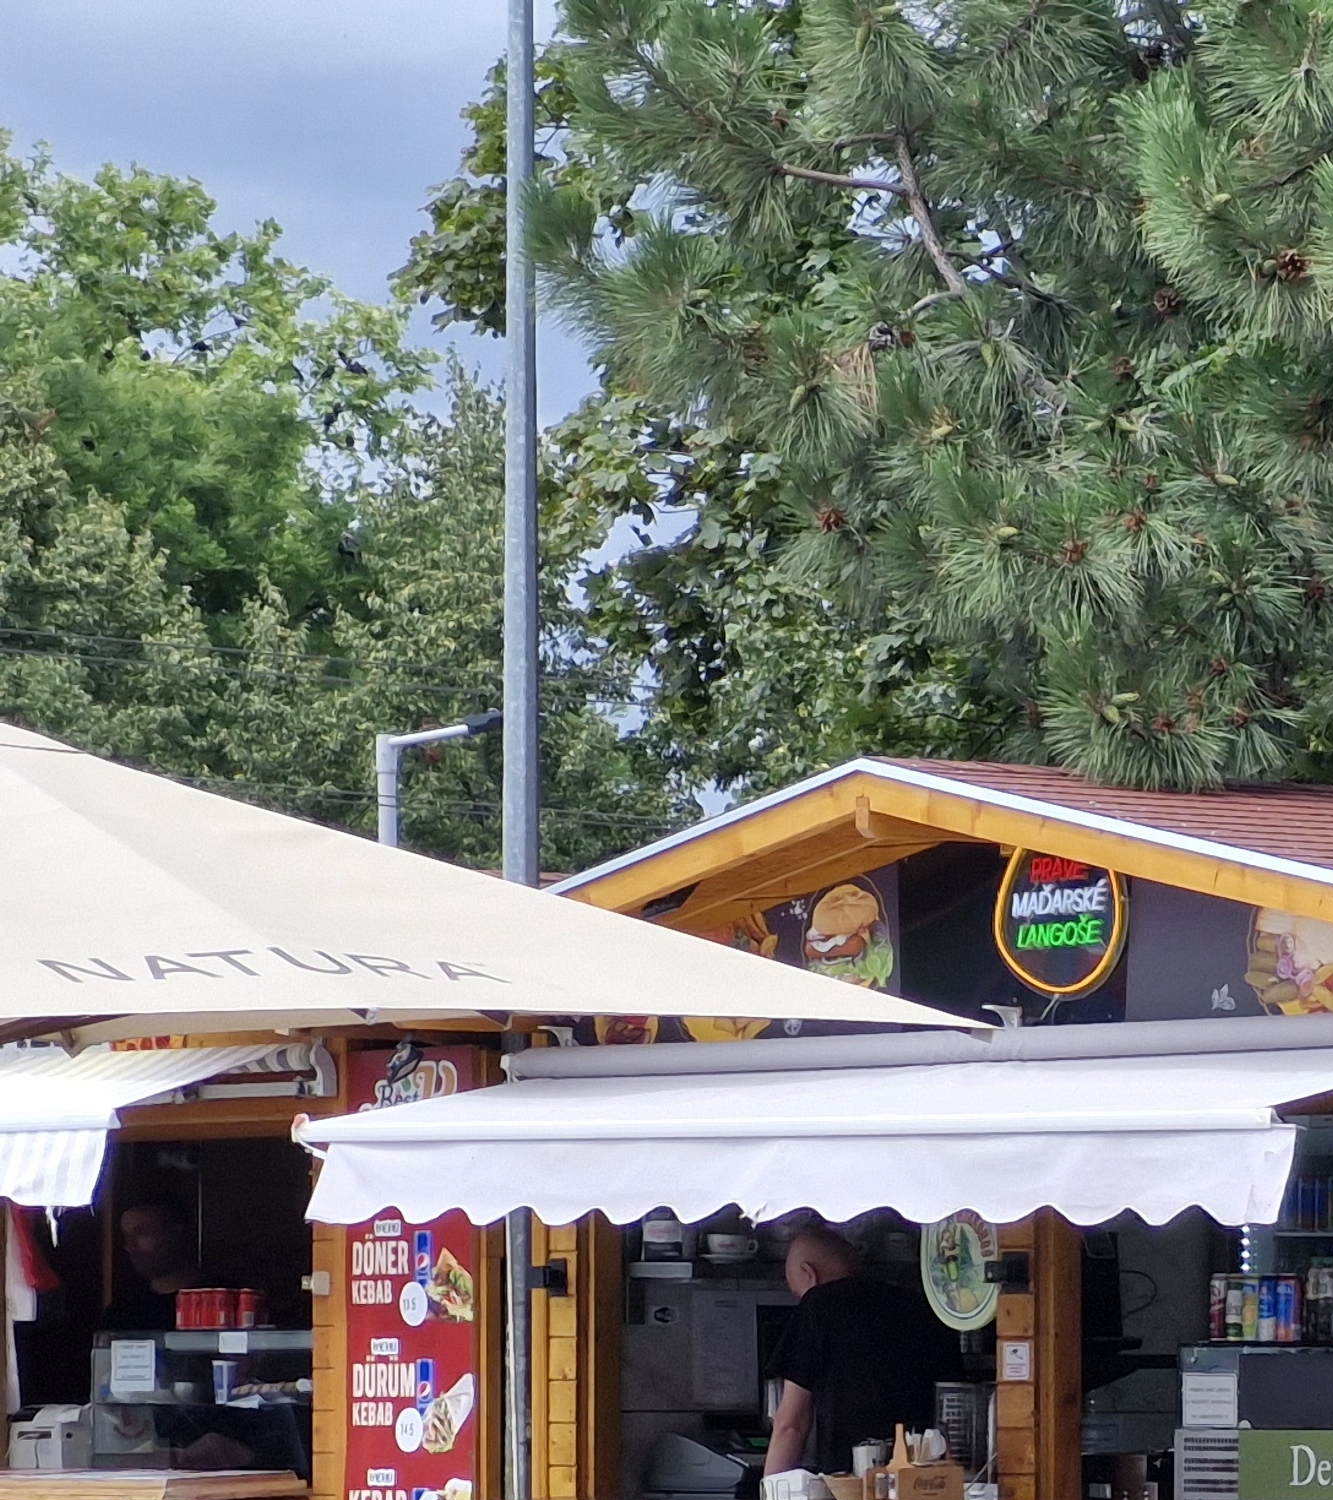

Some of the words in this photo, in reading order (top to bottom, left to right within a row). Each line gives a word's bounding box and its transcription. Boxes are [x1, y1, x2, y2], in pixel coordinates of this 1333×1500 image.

[1011, 878, 1108, 918] MAĎARSKÉ
[1016, 914, 1104, 949] LANGOŠE
[36, 946, 512, 984] NATURA
[352, 1233, 409, 1276] DÖNER
[352, 1279, 392, 1305] KEBAB
[352, 1355, 416, 1398] DÜRÜM
[352, 1402, 393, 1427] KEBAB
